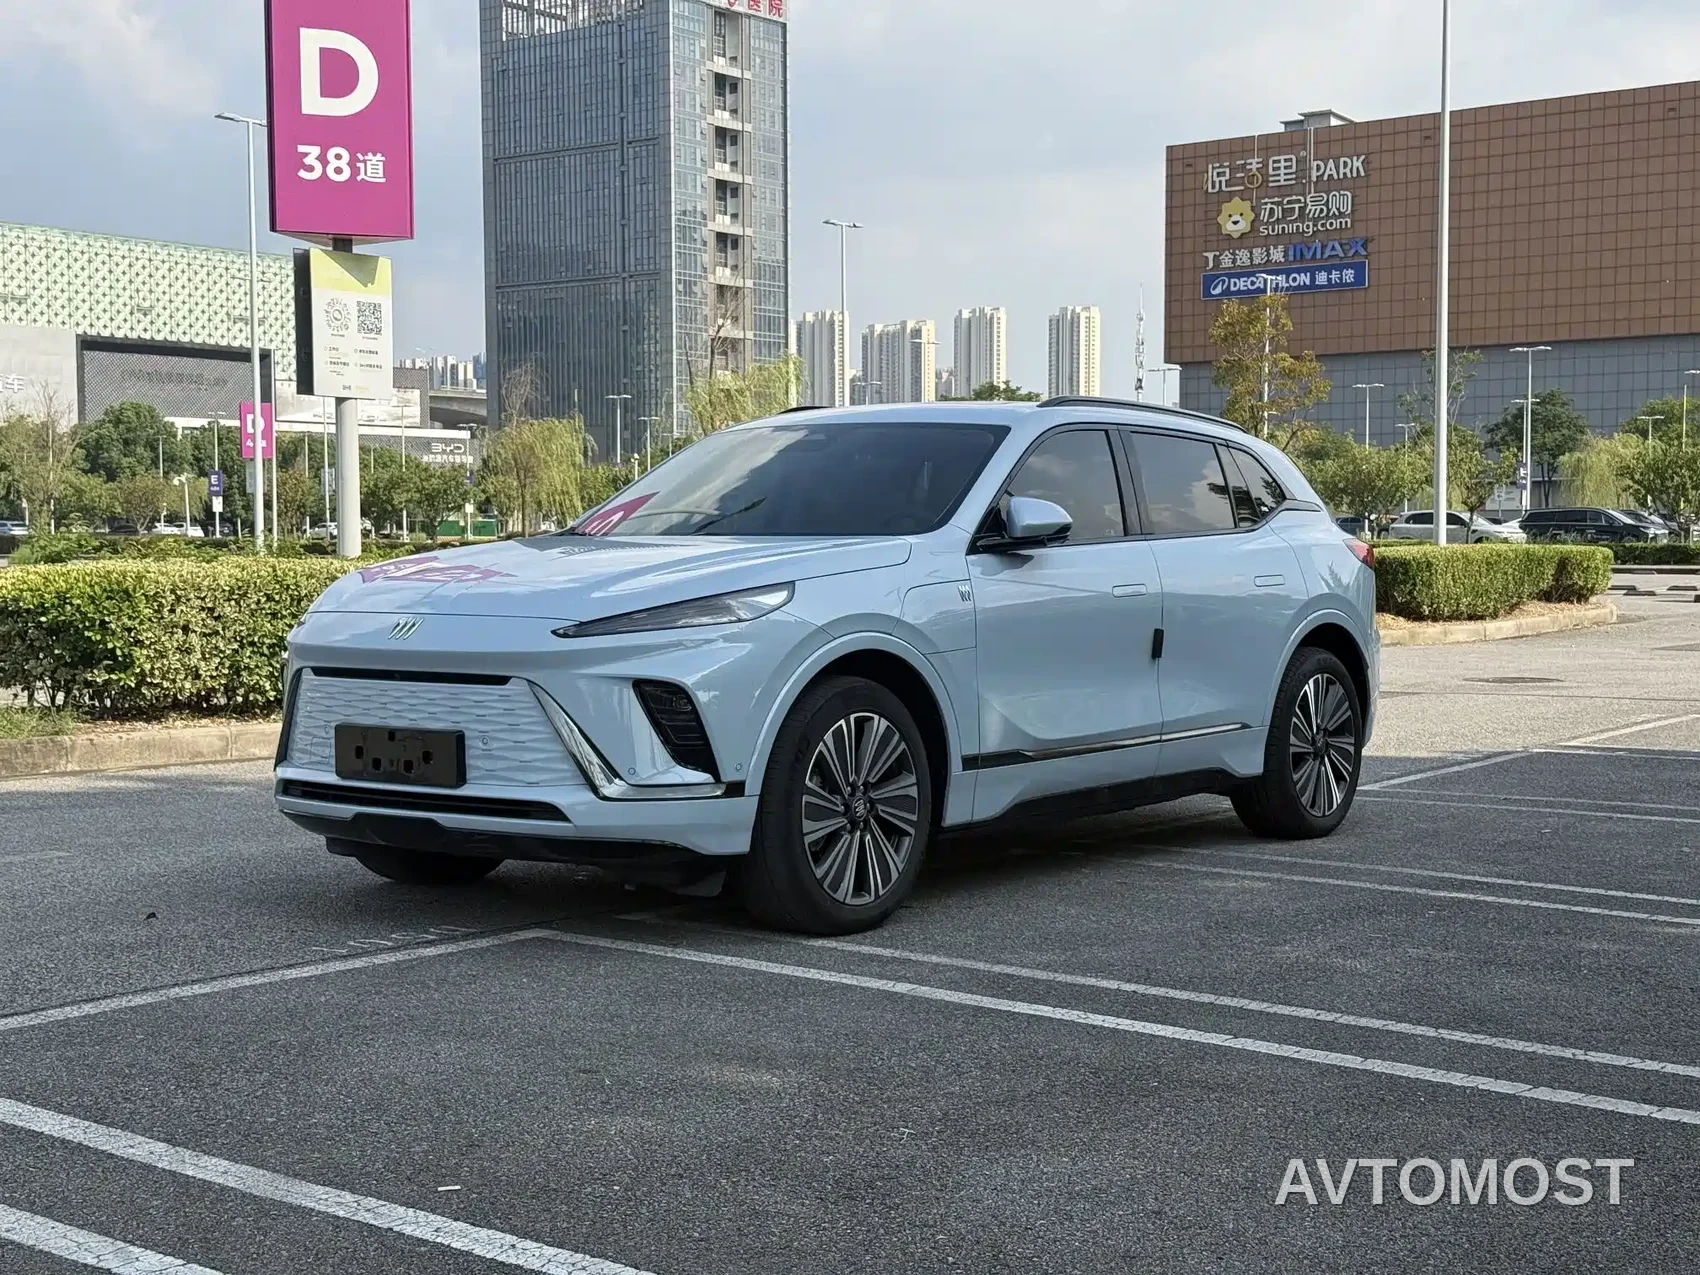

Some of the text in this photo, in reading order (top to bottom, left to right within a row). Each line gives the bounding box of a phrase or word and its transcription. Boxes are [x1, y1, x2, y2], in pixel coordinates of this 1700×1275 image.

[299, 27, 379, 117] D
[297, 144, 387, 183] 38道
[1203, 154, 1297, 193] 悦活里
[1259, 190, 1352, 223] 苏宁易购
[1259, 217, 1352, 236] suning.com
[1219, 244, 1285, 268] 金逸影城
[1288, 237, 1367, 261] IMAX
[1230, 268, 1355, 291] DECAHLON 迪卡侬
[0, 372, 25, 393] 车
[431, 442, 464, 453] BYD
